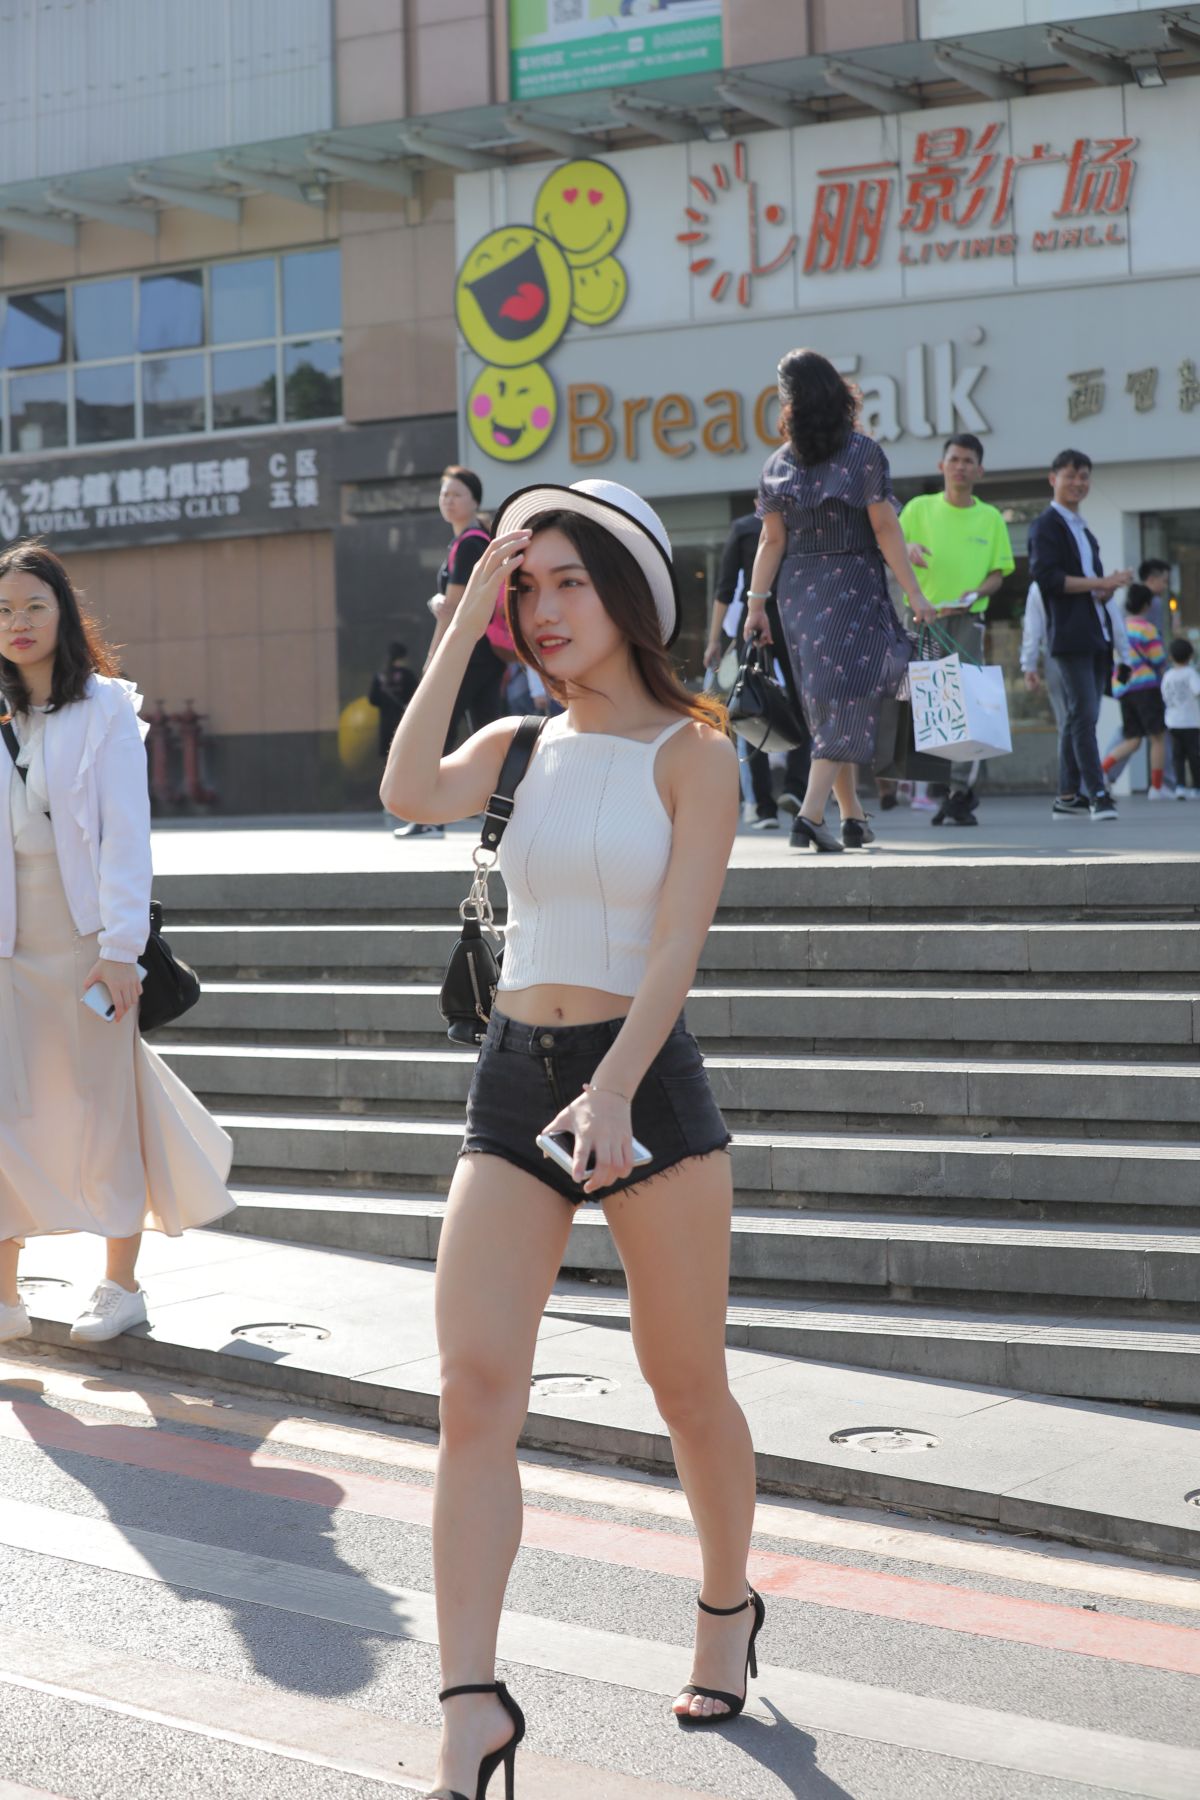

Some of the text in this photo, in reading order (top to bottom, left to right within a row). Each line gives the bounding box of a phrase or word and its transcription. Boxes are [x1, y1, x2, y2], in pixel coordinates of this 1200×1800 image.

[803, 122, 1139, 274] 丽影广场
[899, 221, 1127, 265] LIVING MALL
[566, 341, 991, 464] Breaalk
[26, 494, 241, 534] TOTAL FITNESS CLUB
